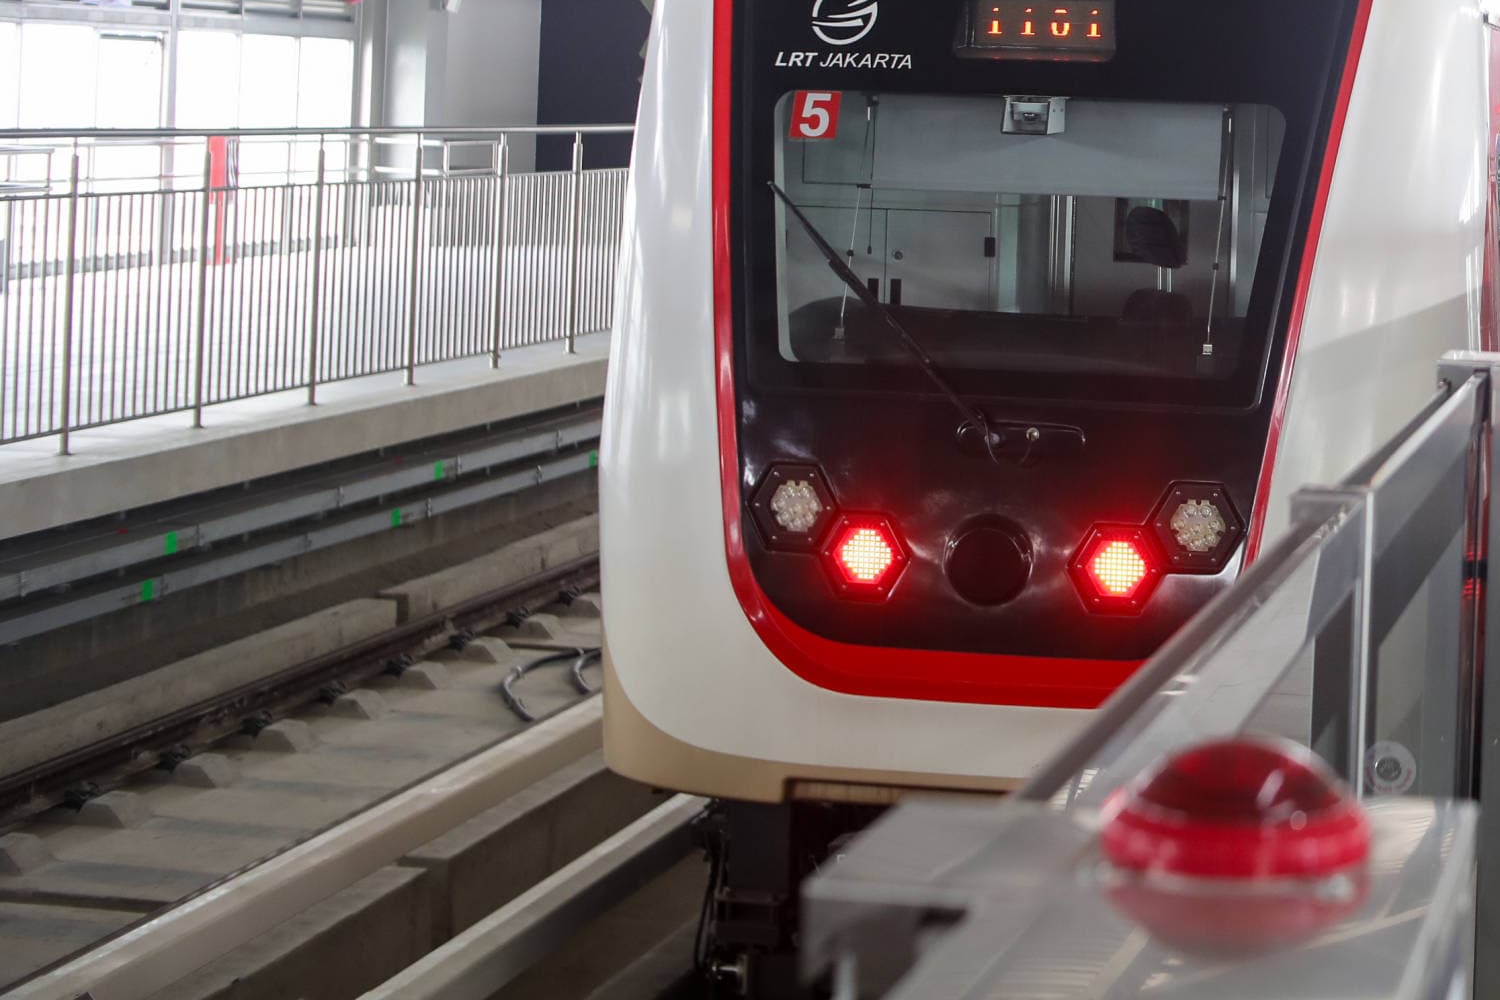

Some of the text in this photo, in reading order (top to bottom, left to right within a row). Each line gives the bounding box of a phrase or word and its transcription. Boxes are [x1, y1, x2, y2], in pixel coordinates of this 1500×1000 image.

[774, 51, 913, 69] LRT JAKARTA
[799, 92, 833, 137] 5
